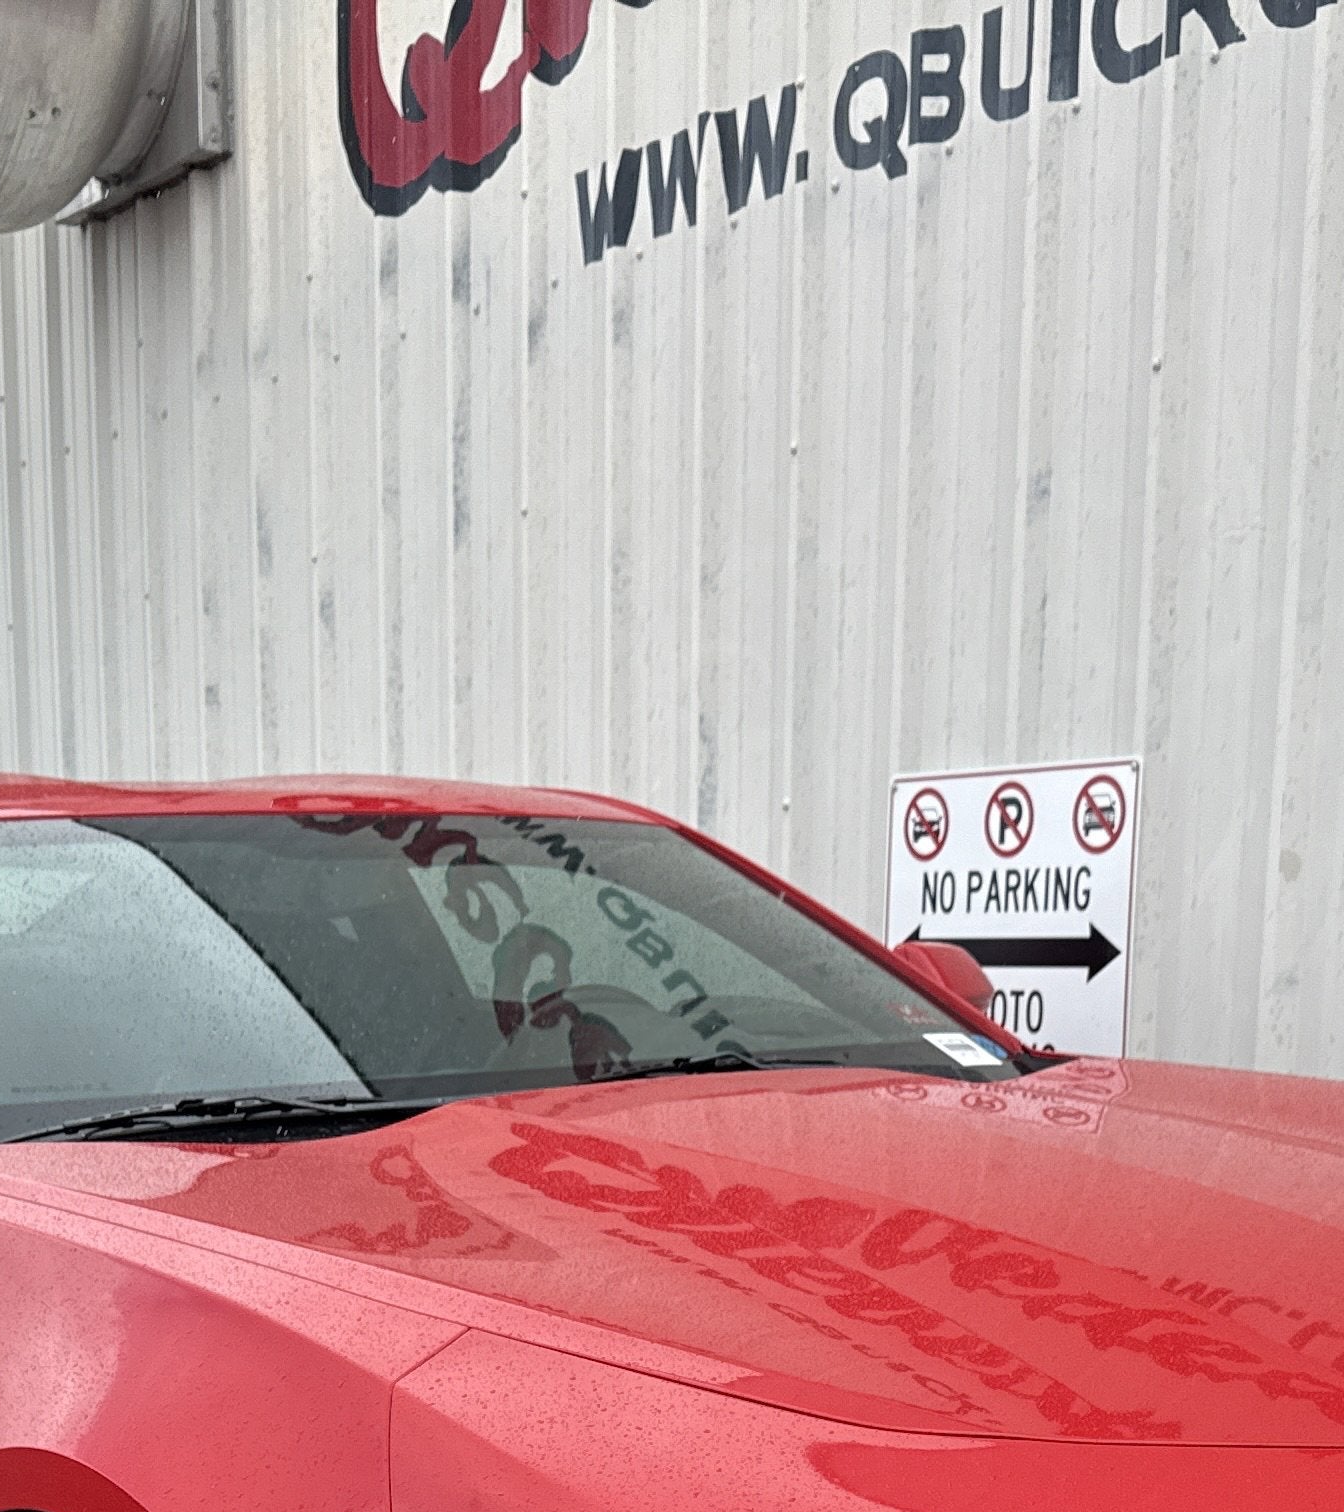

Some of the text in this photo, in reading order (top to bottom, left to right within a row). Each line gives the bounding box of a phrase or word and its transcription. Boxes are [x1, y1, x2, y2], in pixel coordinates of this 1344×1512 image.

[921, 866, 1092, 914] NO PARKING
[990, 990, 1043, 1033] OTO
